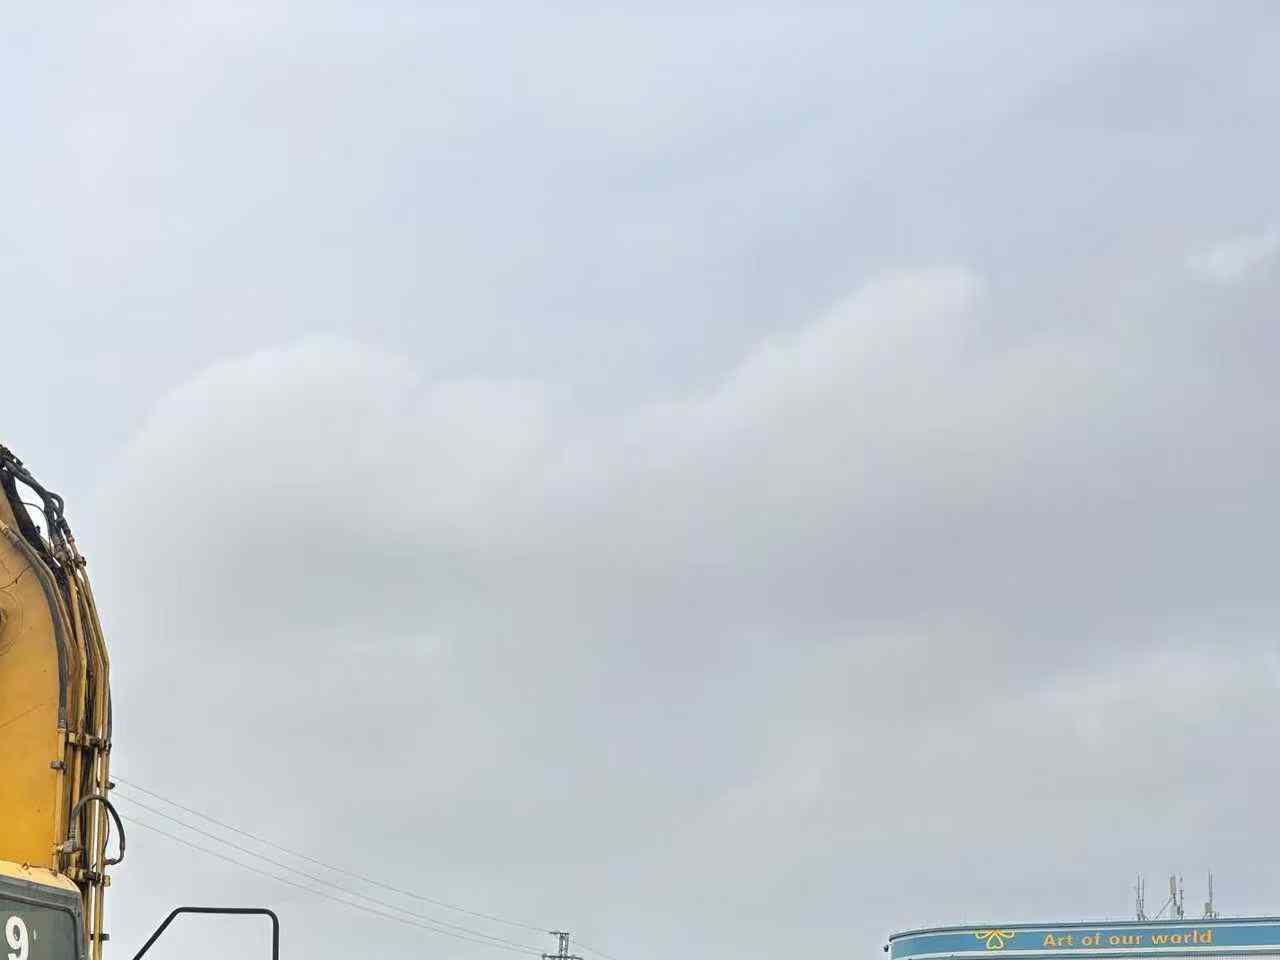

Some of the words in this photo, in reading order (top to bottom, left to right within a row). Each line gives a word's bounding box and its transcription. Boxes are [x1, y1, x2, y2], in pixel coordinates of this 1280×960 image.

[1043, 934, 1074, 947] Art
[1082, 932, 1102, 946] of
[1109, 935, 1141, 945] our
[1152, 929, 1213, 945] world
